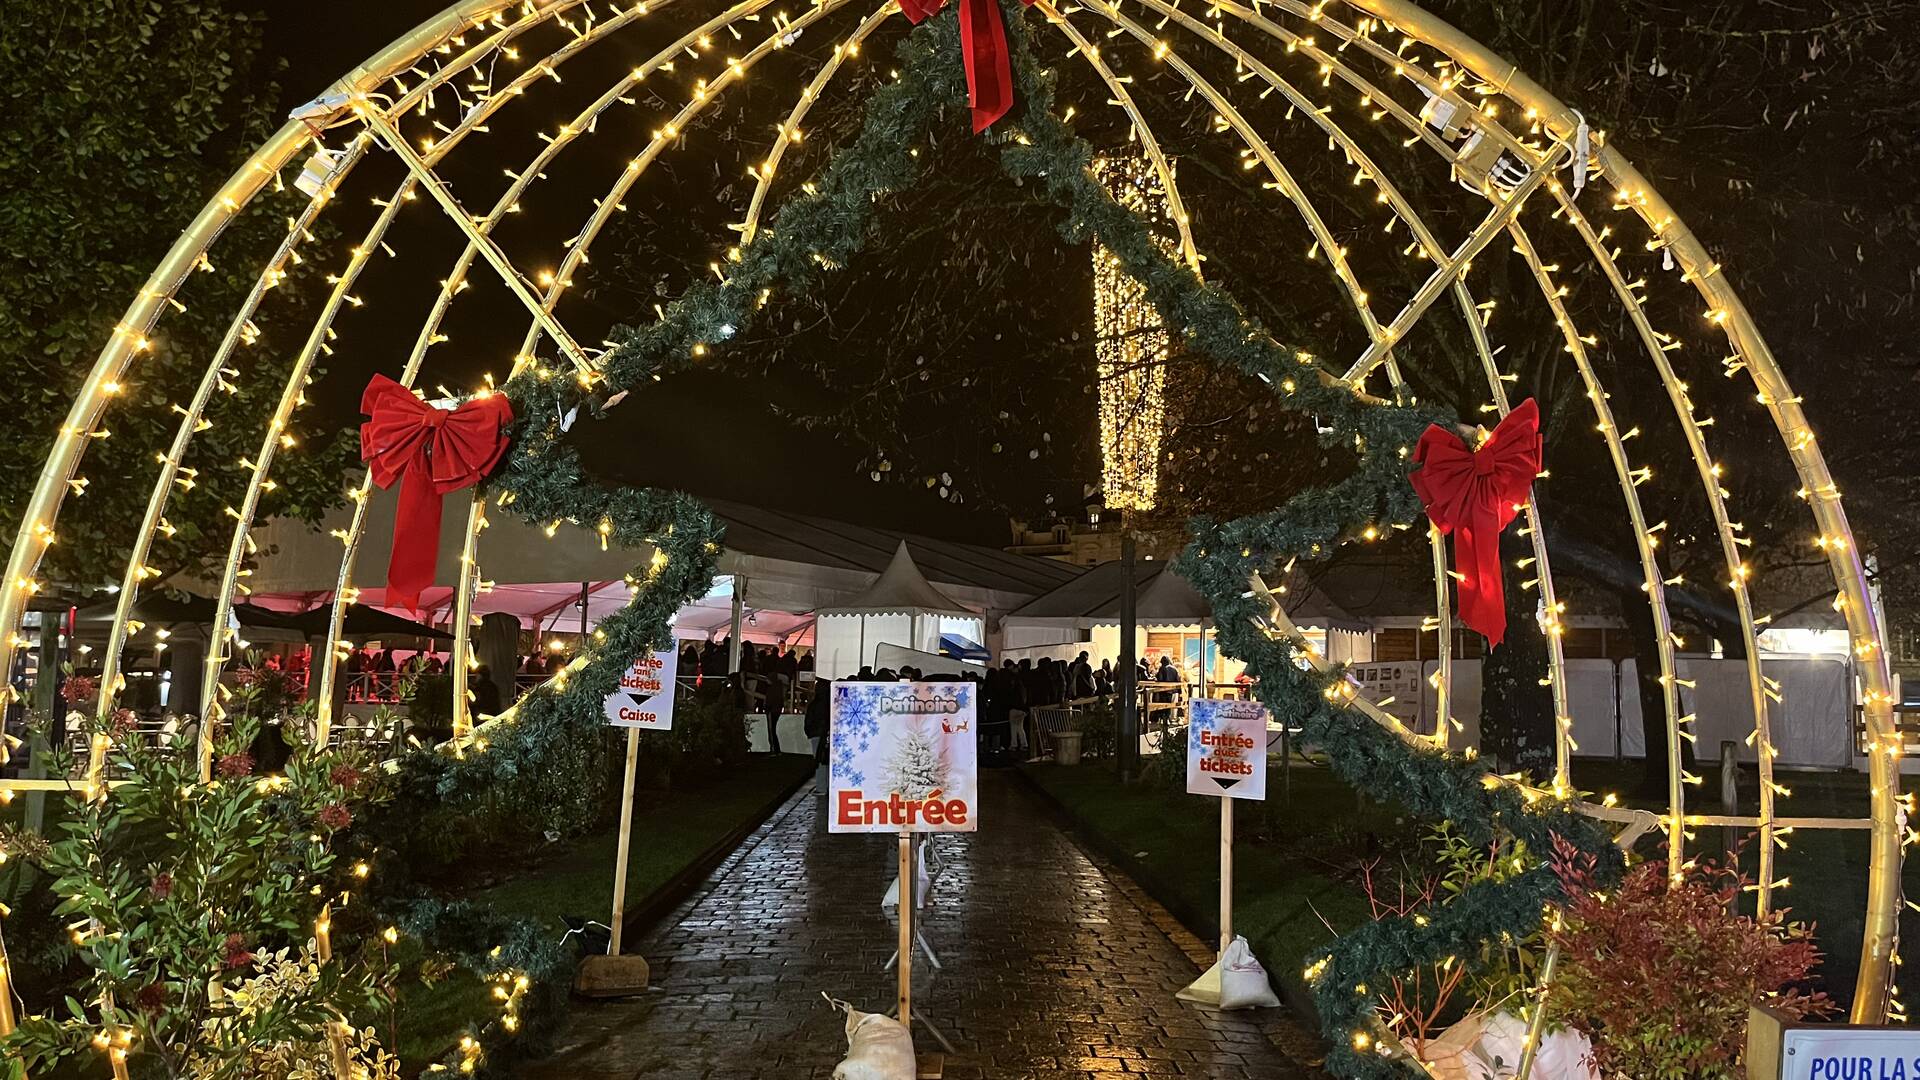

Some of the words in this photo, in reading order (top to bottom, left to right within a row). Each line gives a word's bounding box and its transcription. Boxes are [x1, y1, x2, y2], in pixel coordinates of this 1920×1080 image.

[620, 676, 661, 691] tickets
[881, 695, 958, 714] Patinoire
[619, 707, 656, 723] Caisse
[1200, 730, 1254, 749] Entrée
[1213, 748, 1241, 758] avec
[1199, 758, 1253, 775] tickets
[837, 789, 968, 826] Entrée
[1810, 1057, 1873, 1080] POUR
[1880, 1057, 1906, 1080] LA
